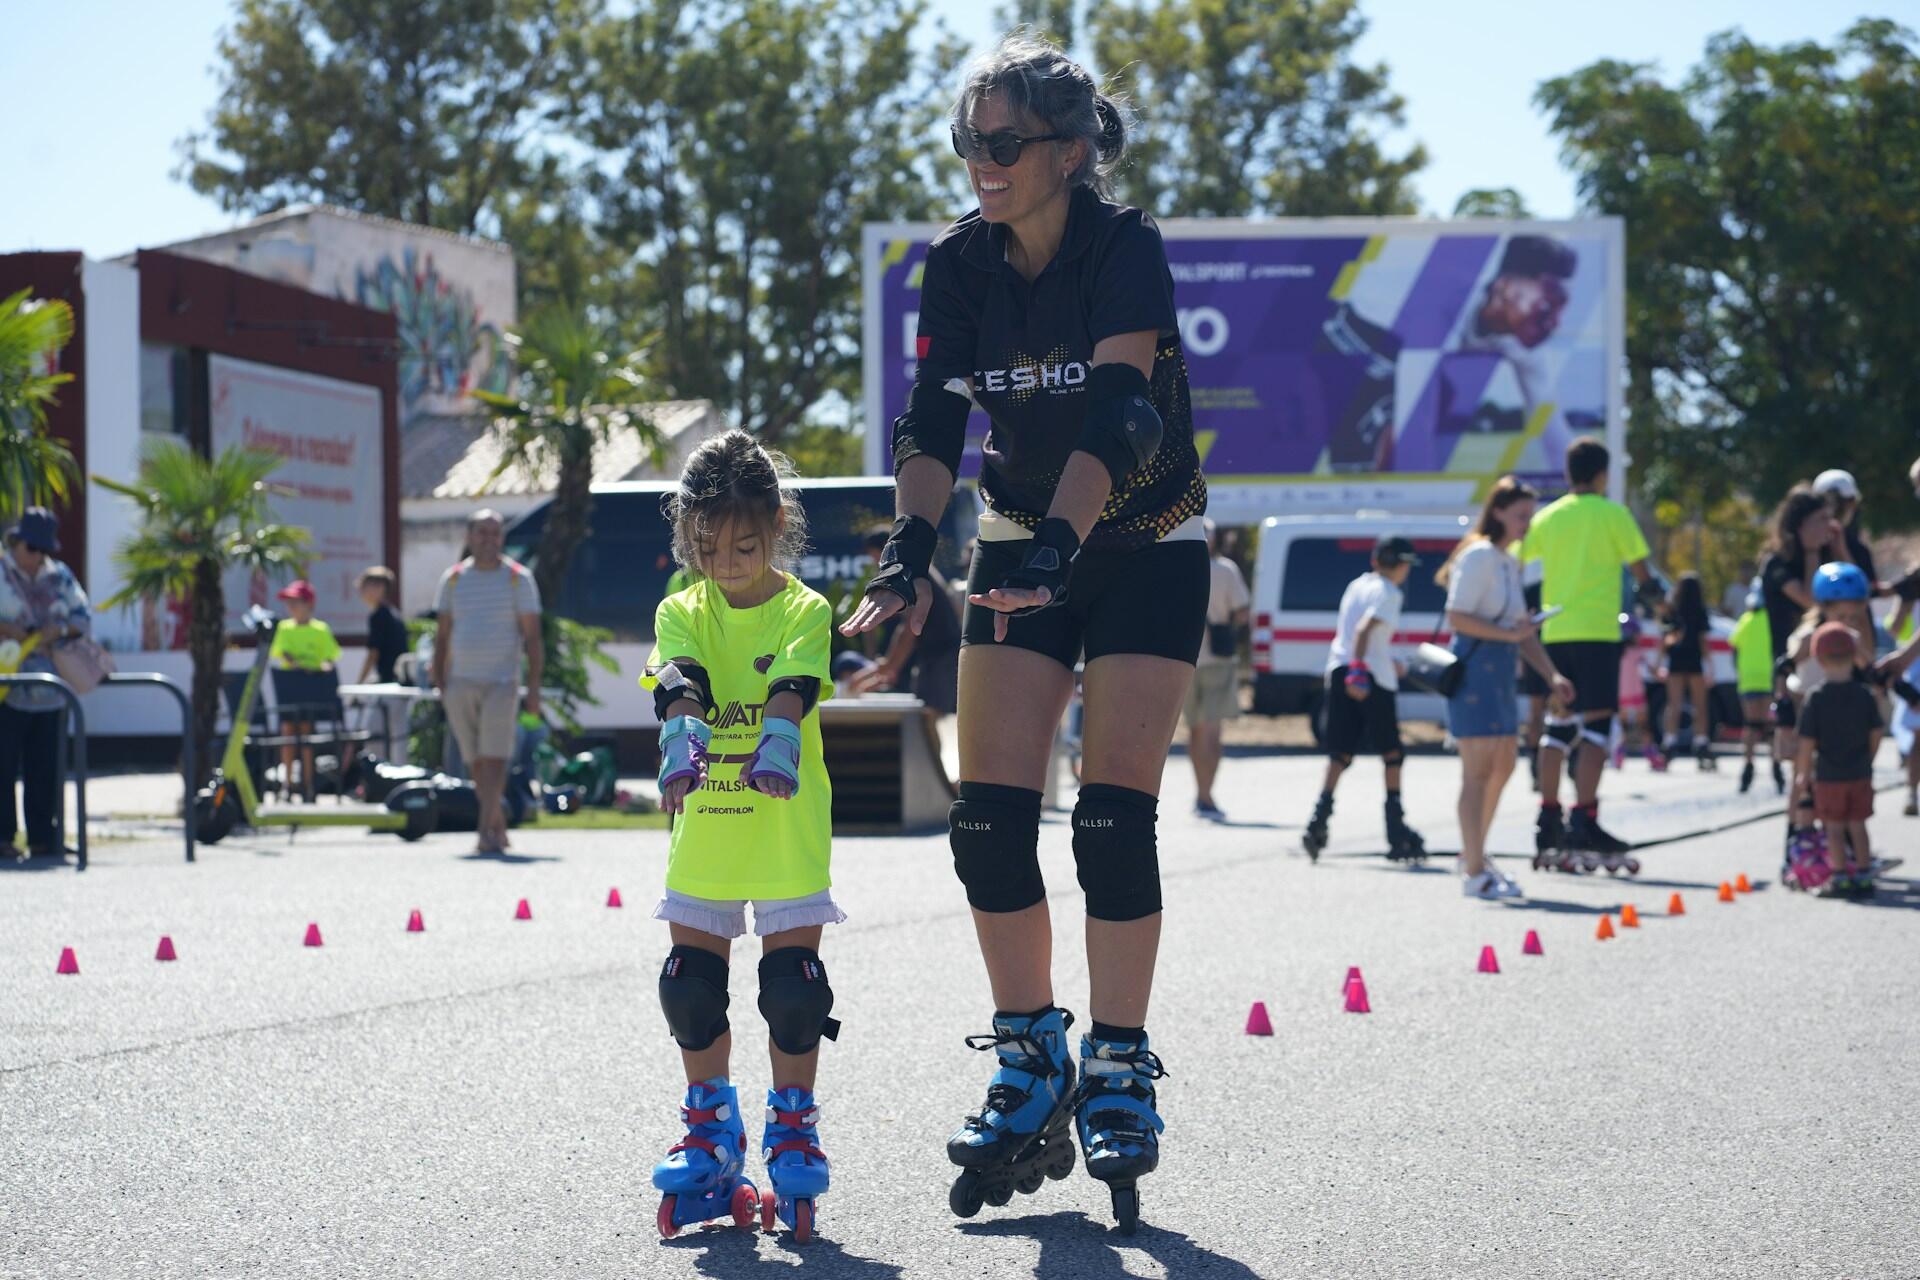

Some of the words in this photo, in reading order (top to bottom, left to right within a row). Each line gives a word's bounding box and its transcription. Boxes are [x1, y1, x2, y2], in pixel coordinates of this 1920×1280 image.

[708, 806, 754, 815] DECATHLON
[958, 820, 991, 831] ALLSIX
[1080, 818, 1114, 828] ALLSIX
